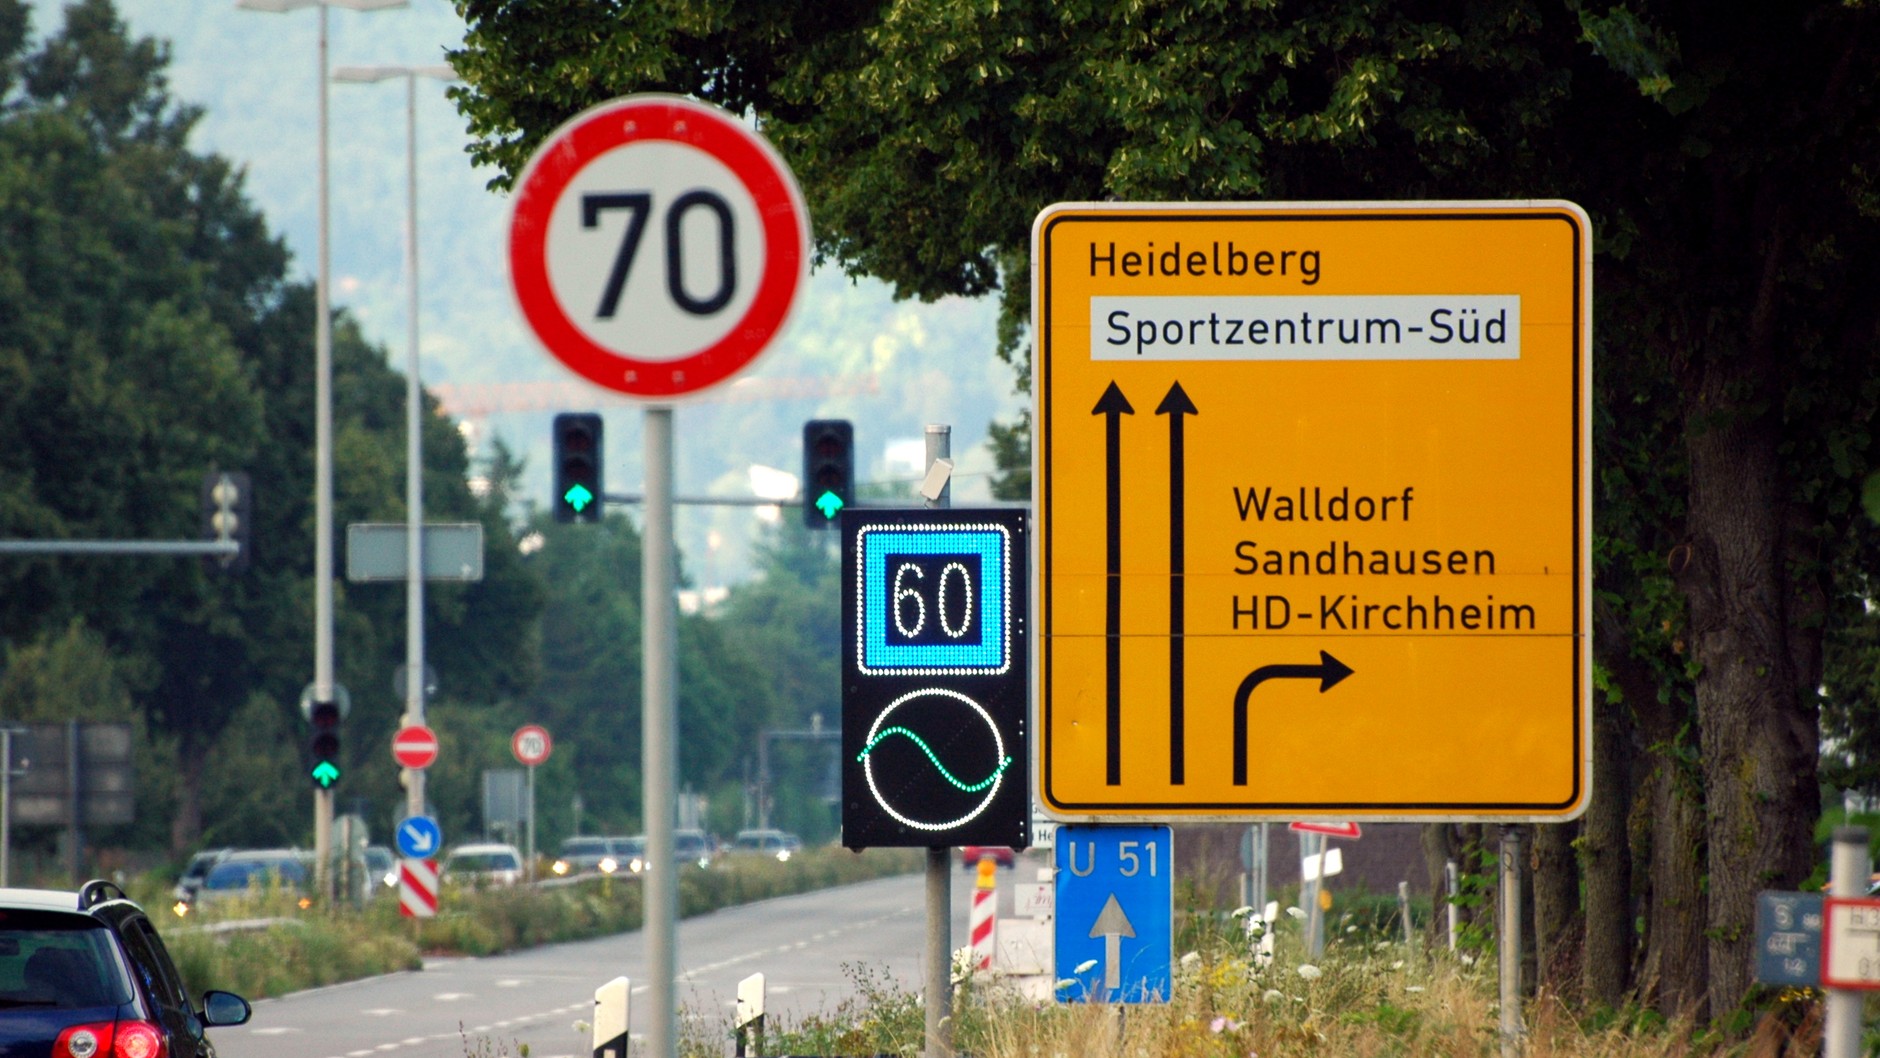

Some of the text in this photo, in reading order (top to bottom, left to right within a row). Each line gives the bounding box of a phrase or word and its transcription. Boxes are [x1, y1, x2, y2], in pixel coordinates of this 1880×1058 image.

[580, 189, 738, 320] 70
[1090, 241, 1321, 285] Heidelberg
[1106, 308, 1507, 355] Sportzentrum-Süd
[1233, 487, 1414, 522] Walldorf
[1234, 540, 1496, 575] Sandhausen
[892, 561, 974, 640] 60
[1233, 595, 1536, 630] HD-Kirchheim
[523, 736, 542, 755] 70
[1069, 841, 1157, 877] U 51
